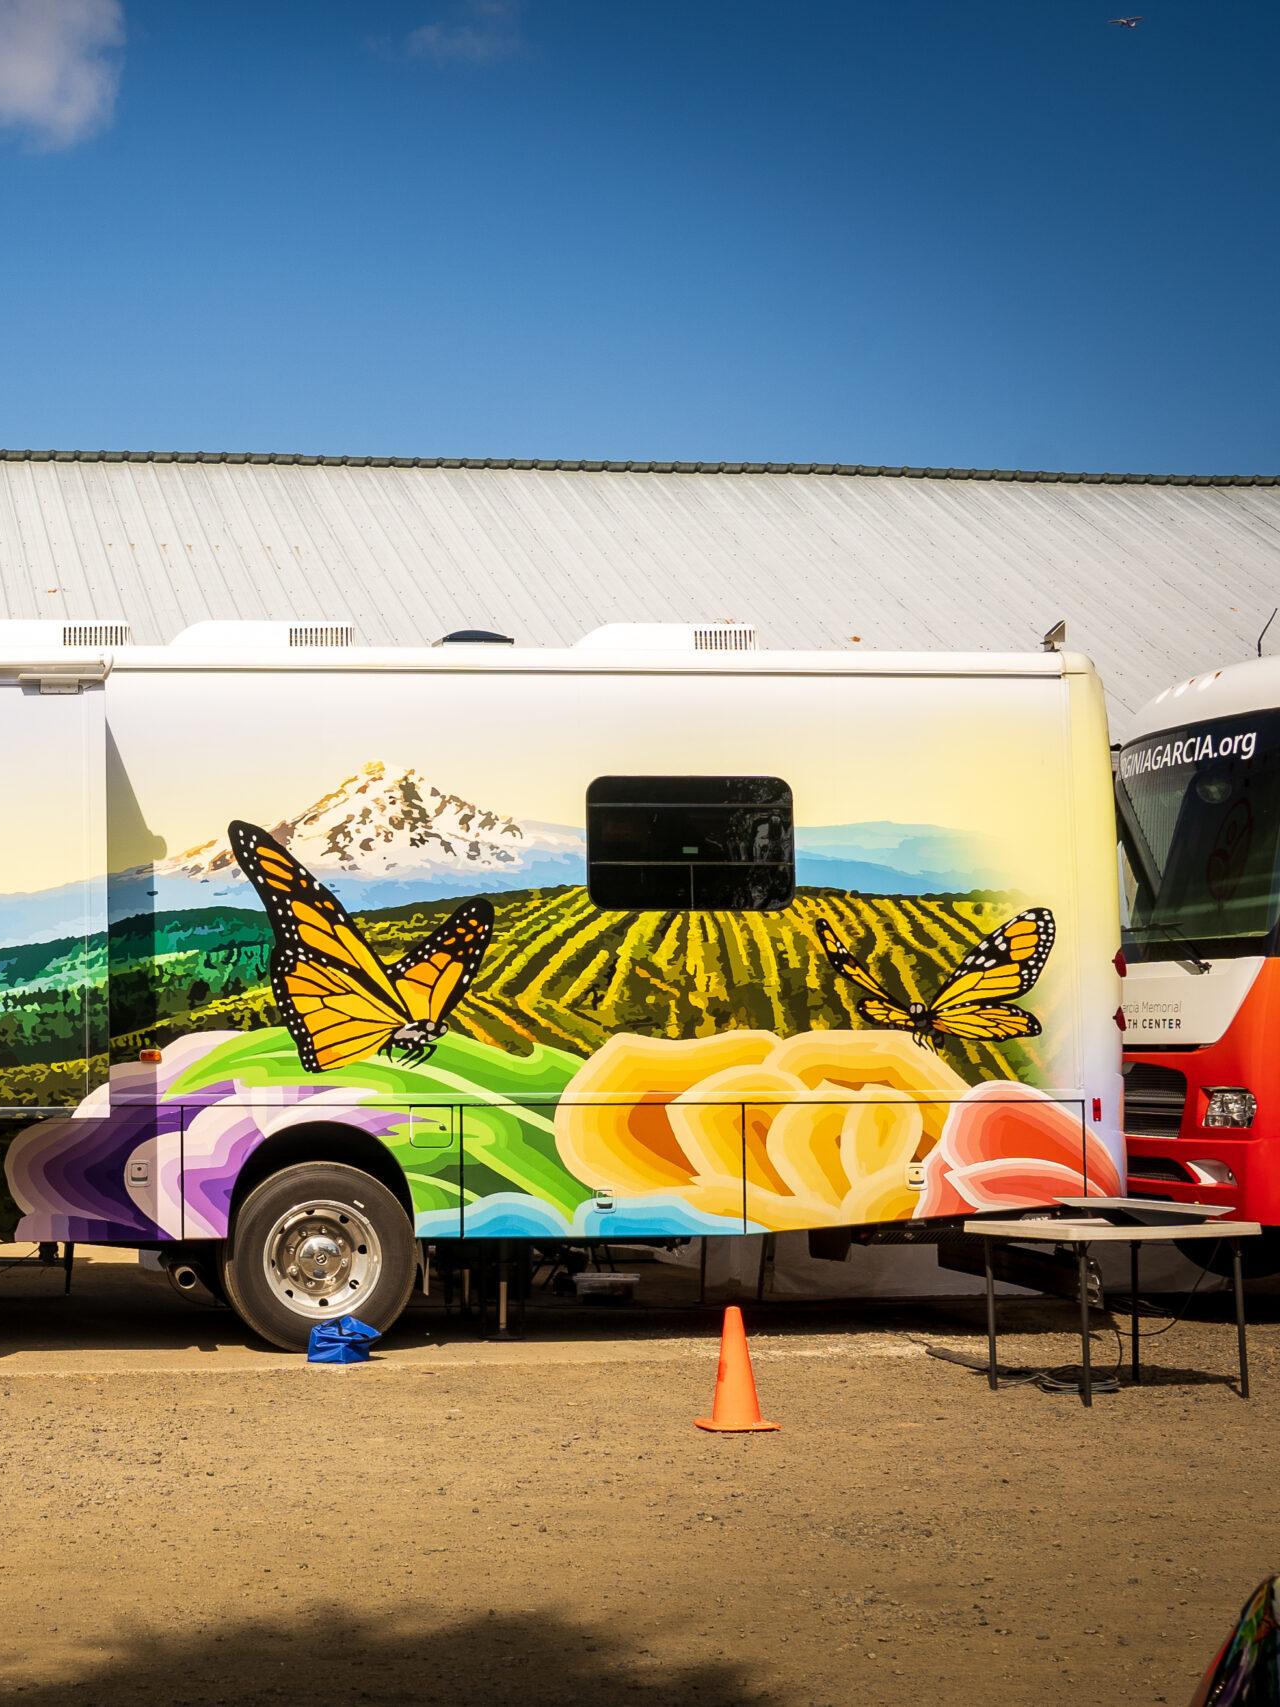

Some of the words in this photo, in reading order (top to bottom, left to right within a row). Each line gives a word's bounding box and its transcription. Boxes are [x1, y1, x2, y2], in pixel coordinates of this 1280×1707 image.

[1120, 732, 1257, 780] RGINIAGARCIA.org
[1122, 1001, 1139, 1013] arcia
[1141, 1001, 1182, 1013] Memorial
[1141, 1018, 1182, 1029] CENTER
